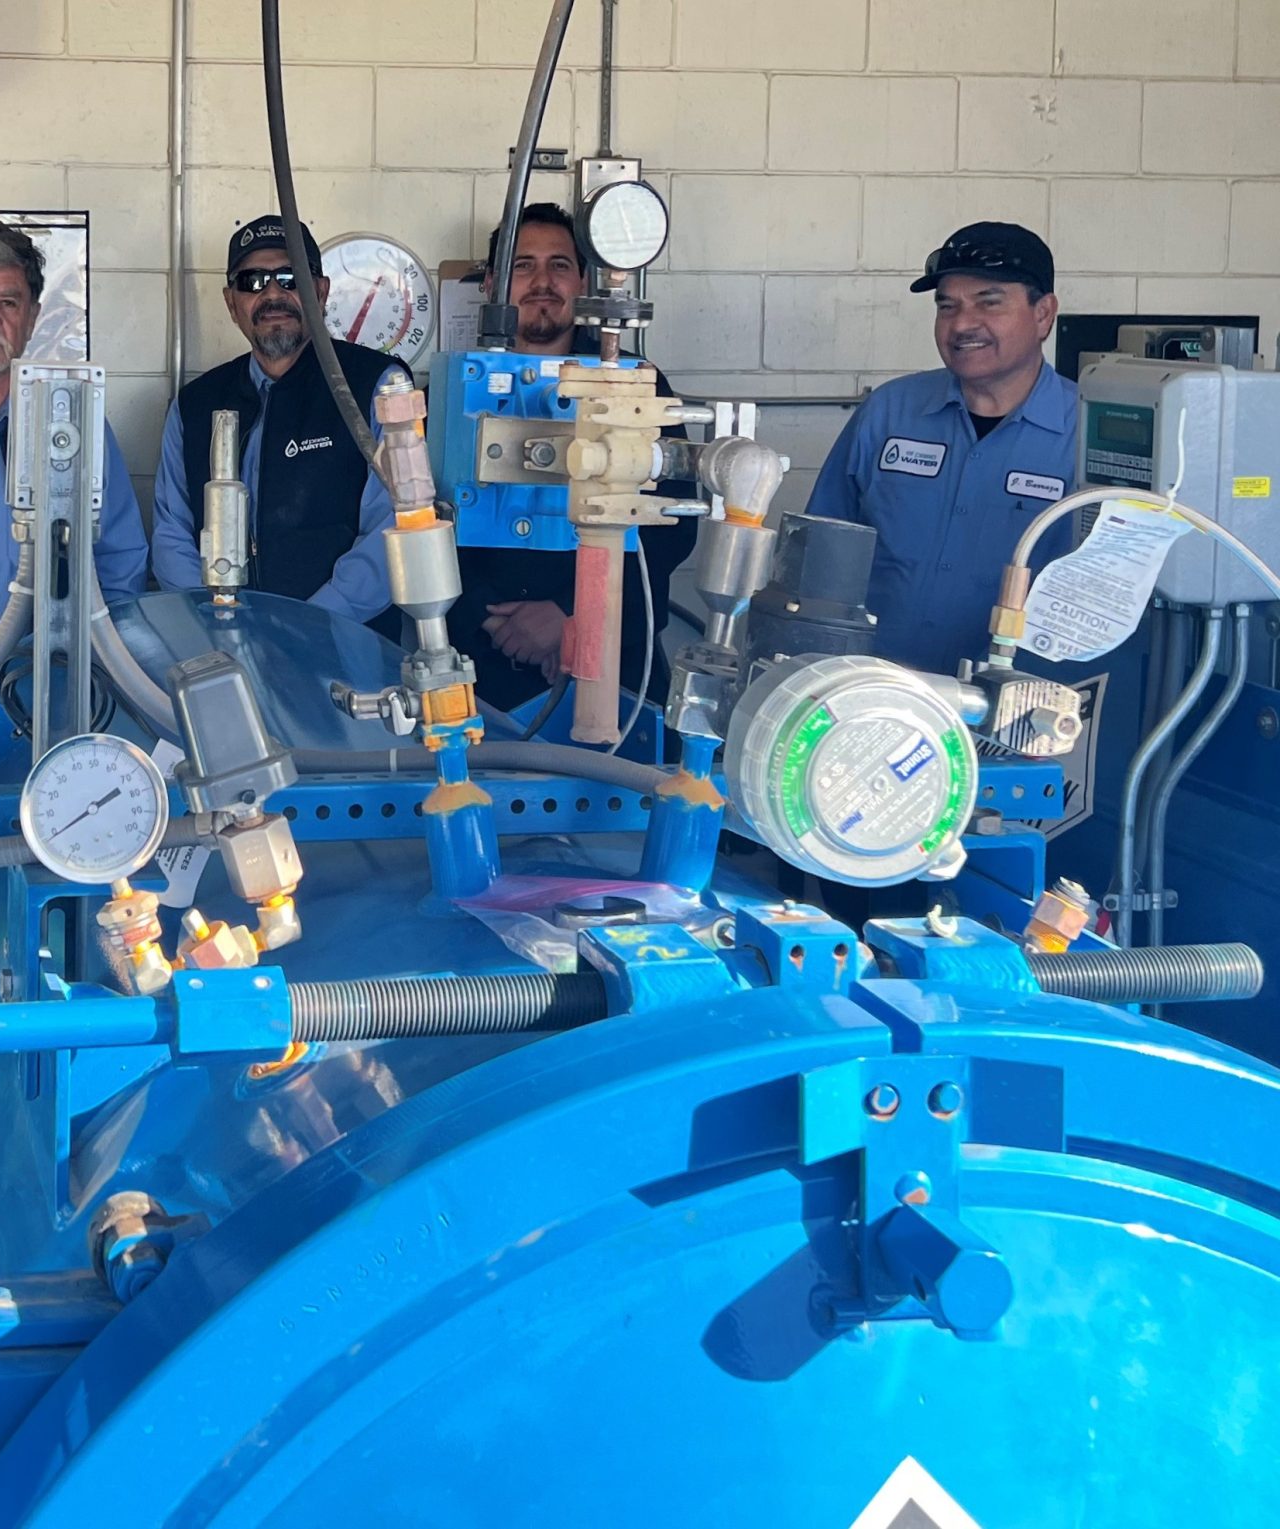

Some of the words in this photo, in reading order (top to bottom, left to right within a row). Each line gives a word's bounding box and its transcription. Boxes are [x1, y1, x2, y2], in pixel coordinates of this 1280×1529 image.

[417, 293, 428, 312] 100
[408, 328, 424, 347] 120
[299, 440, 333, 452] WATER
[901, 455, 938, 468] WATER
[1050, 601, 1110, 632] CAUTION
[71, 761, 83, 771] 40
[88, 759, 99, 769] 50
[105, 763, 117, 773] 60
[121, 775, 132, 784] 70
[48, 790, 60, 800] 20
[129, 788, 141, 798] 80
[46, 809, 55, 818] 10
[131, 806, 142, 816] 90
[125, 822, 138, 833] 100
